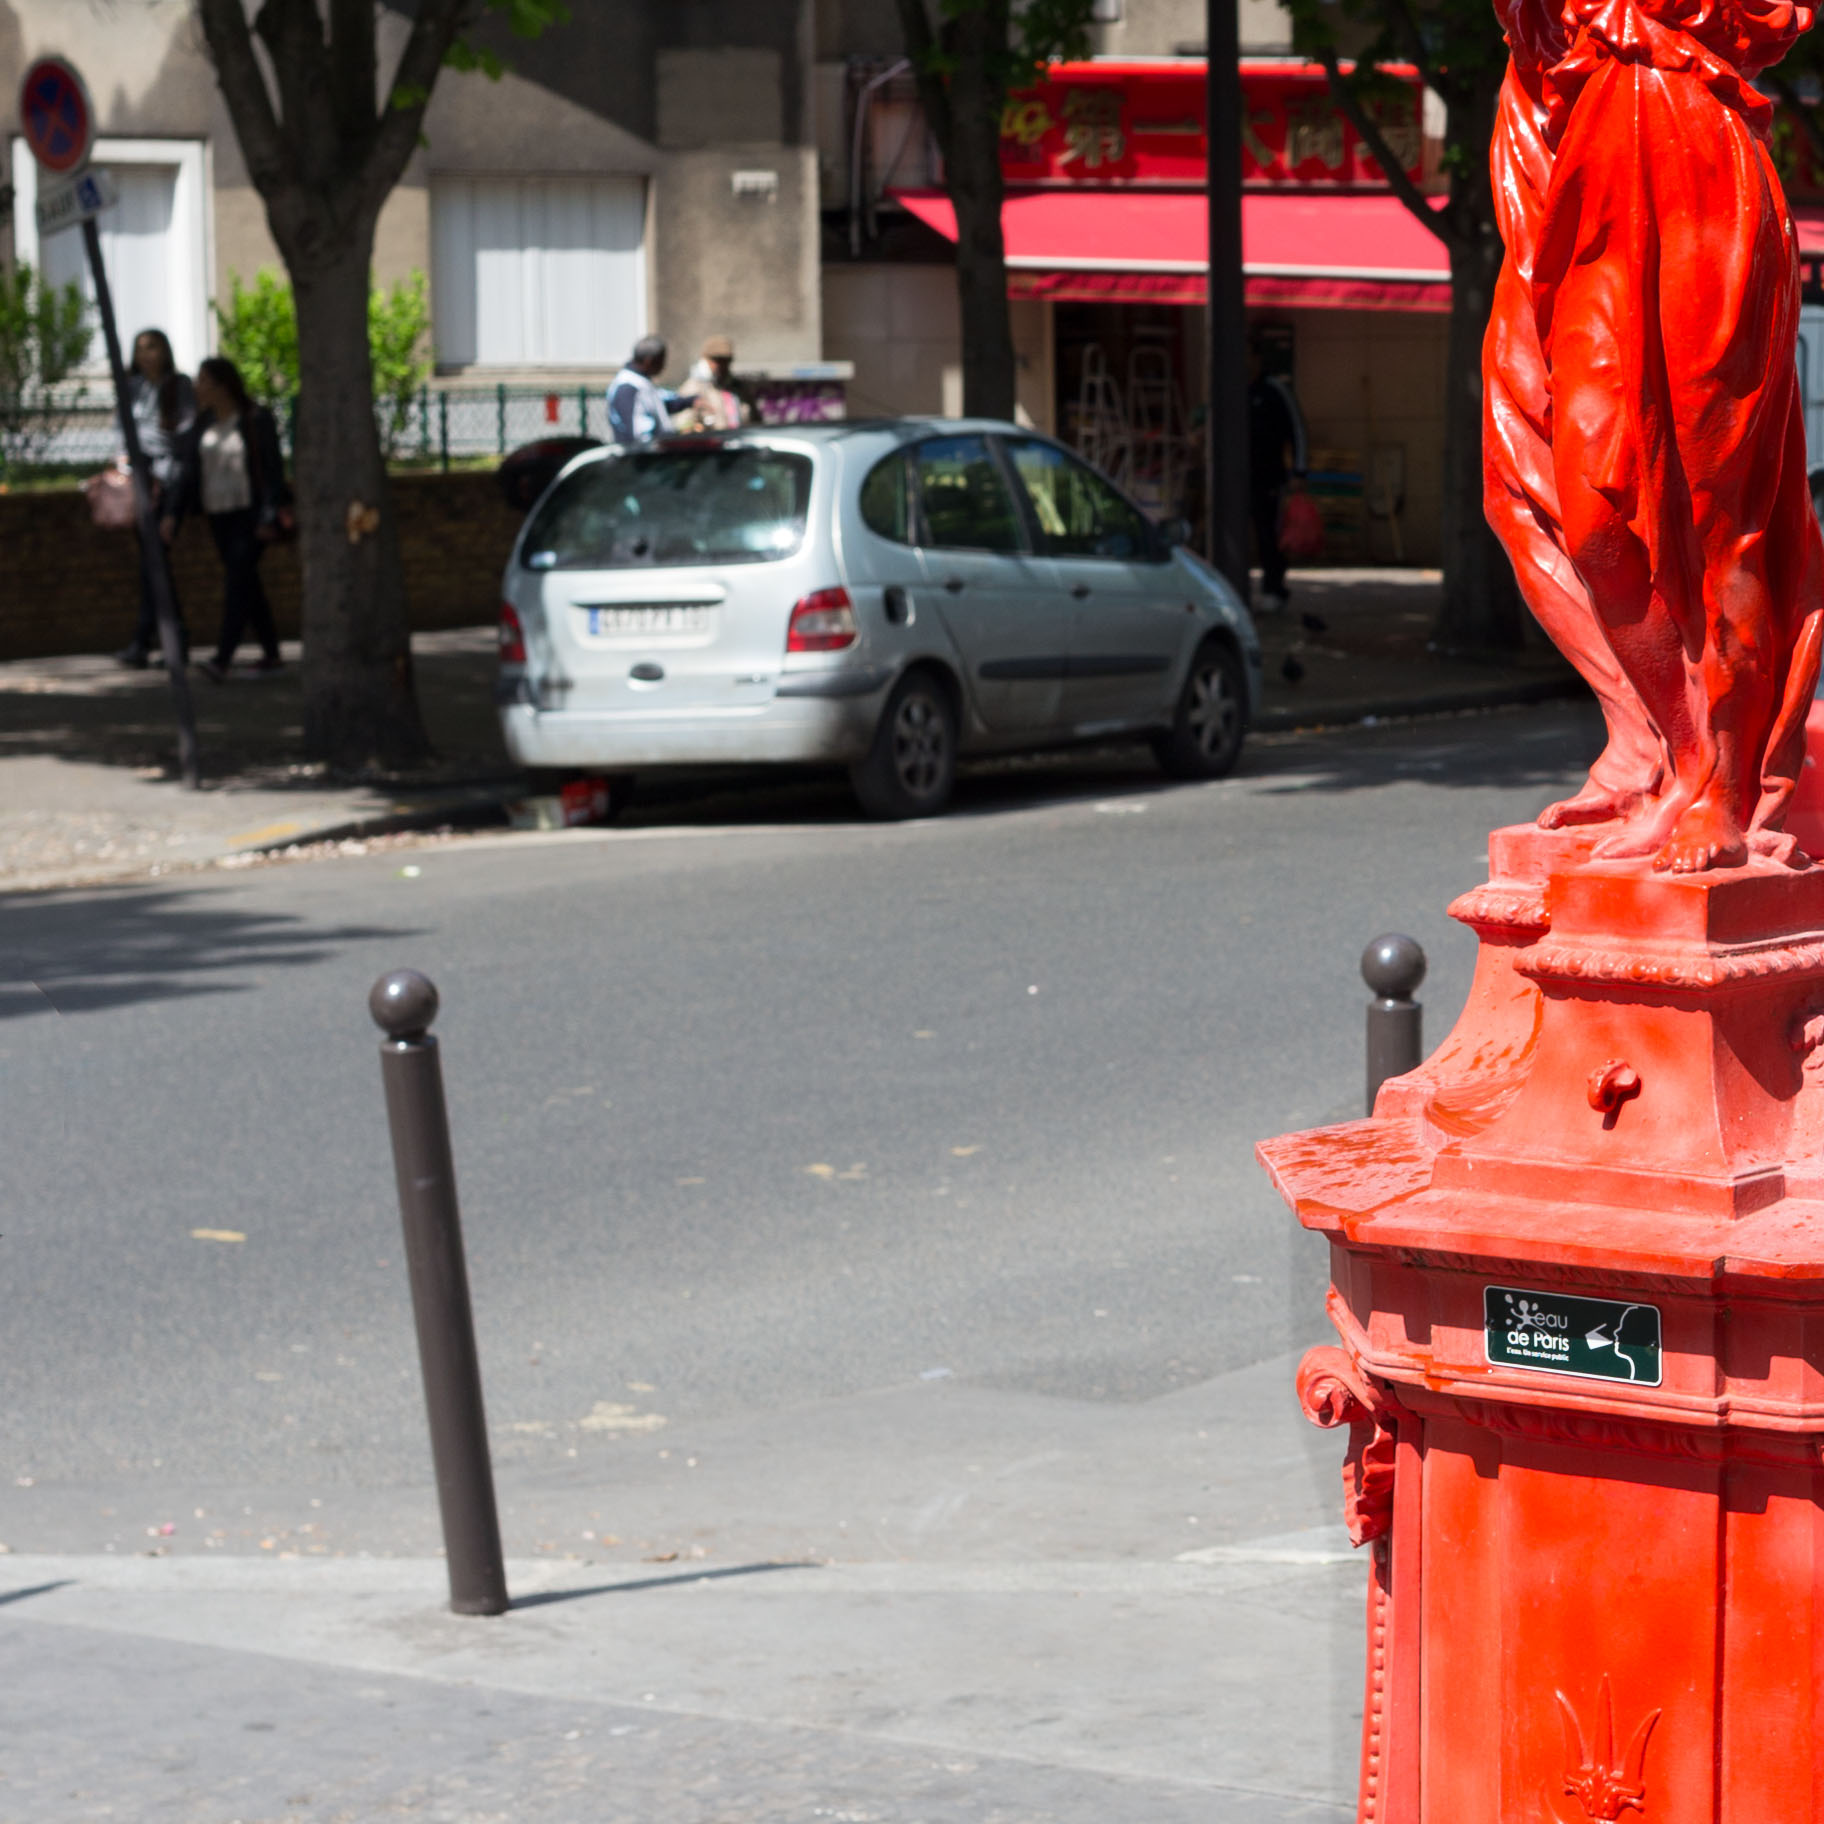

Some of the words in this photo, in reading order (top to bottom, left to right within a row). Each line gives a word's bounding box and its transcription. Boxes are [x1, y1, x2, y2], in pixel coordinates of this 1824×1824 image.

[1535, 1313, 1568, 1328] eau
[1507, 1329, 1529, 1346] de
[1534, 1332, 1569, 1351] Paris
